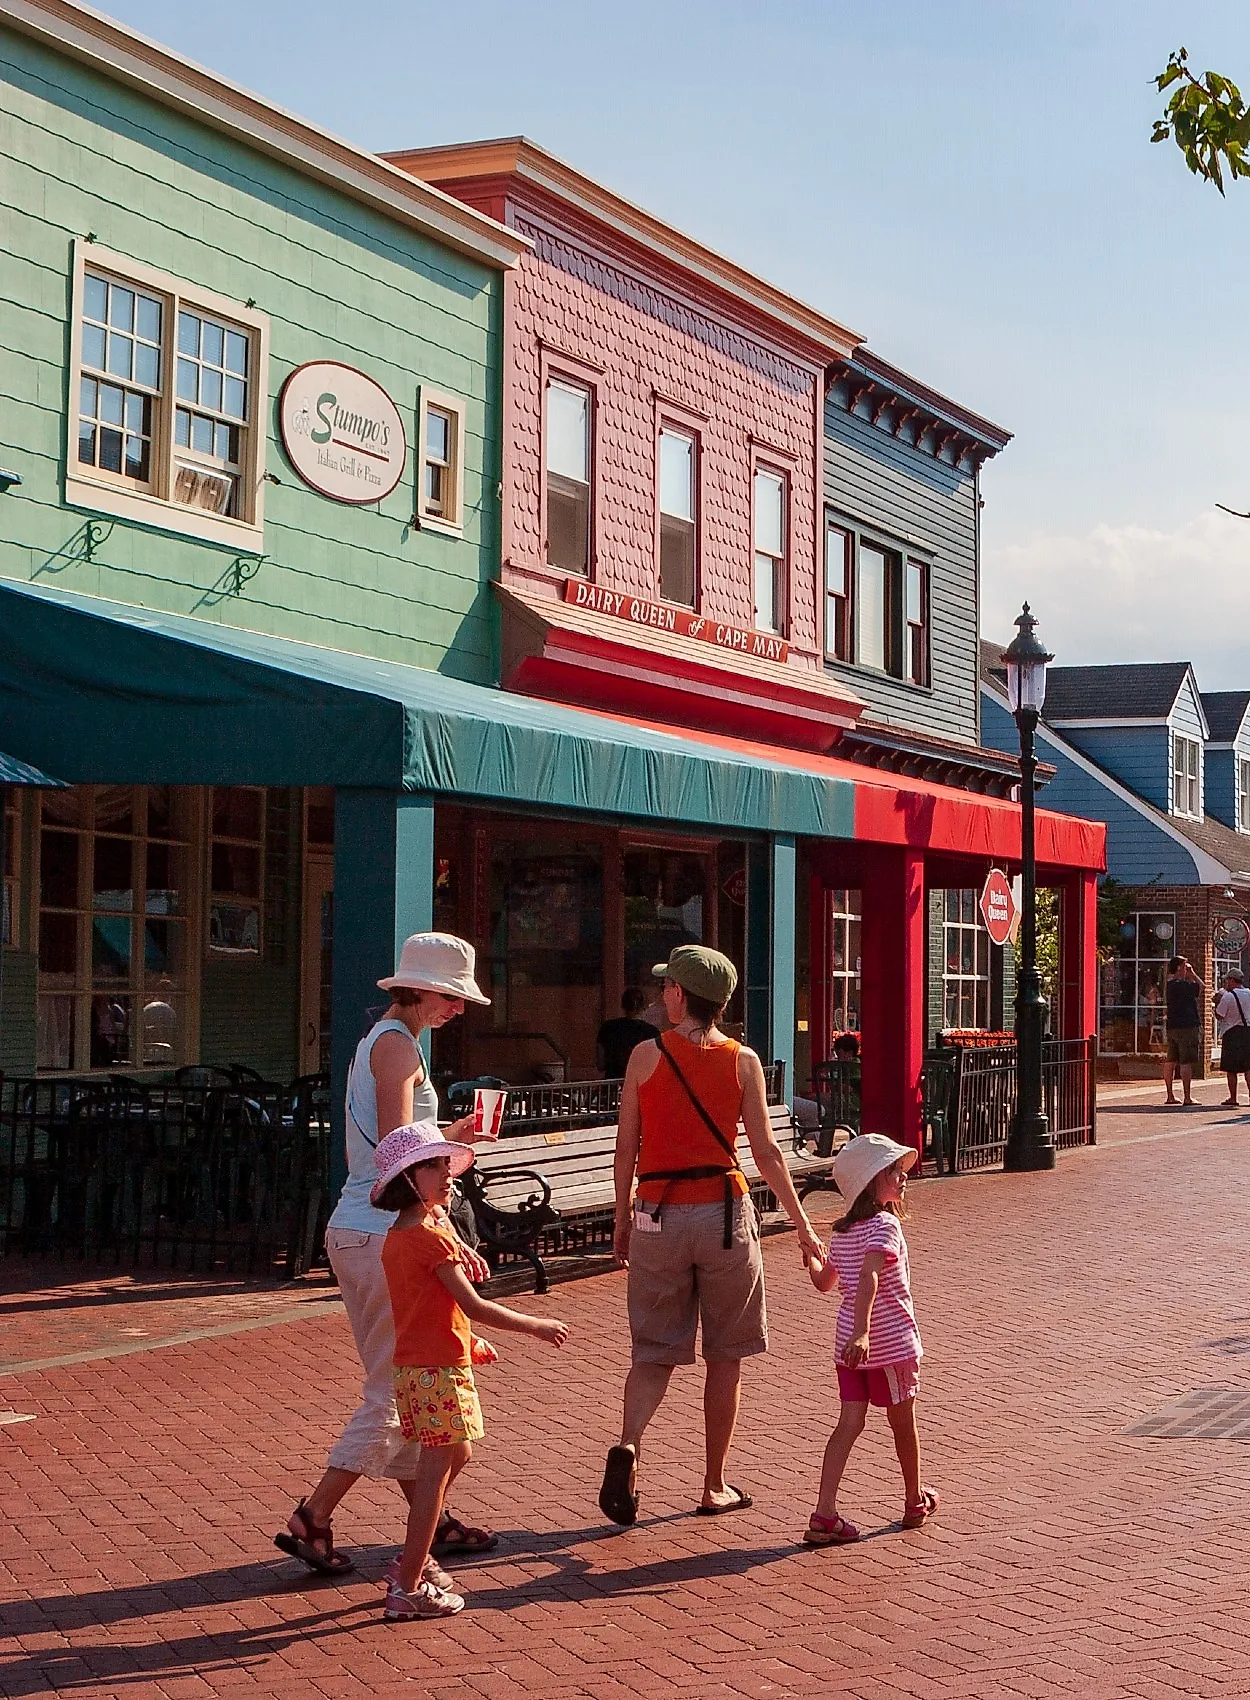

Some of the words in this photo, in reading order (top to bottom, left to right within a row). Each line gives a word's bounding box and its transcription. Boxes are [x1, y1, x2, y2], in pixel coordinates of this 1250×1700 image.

[311, 393, 390, 445] Stumpo's
[317, 448, 338, 470] Italian
[340, 456, 356, 476] Grill
[364, 465, 381, 486] Pizza
[576, 584, 624, 615] DAIRY
[630, 599, 676, 630] QUEEN
[687, 617, 706, 637] of
[716, 624, 748, 650] CAPE
[752, 636, 783, 659] MAY
[988, 904, 1008, 922] Queen
[990, 889, 1008, 909] Dairy
